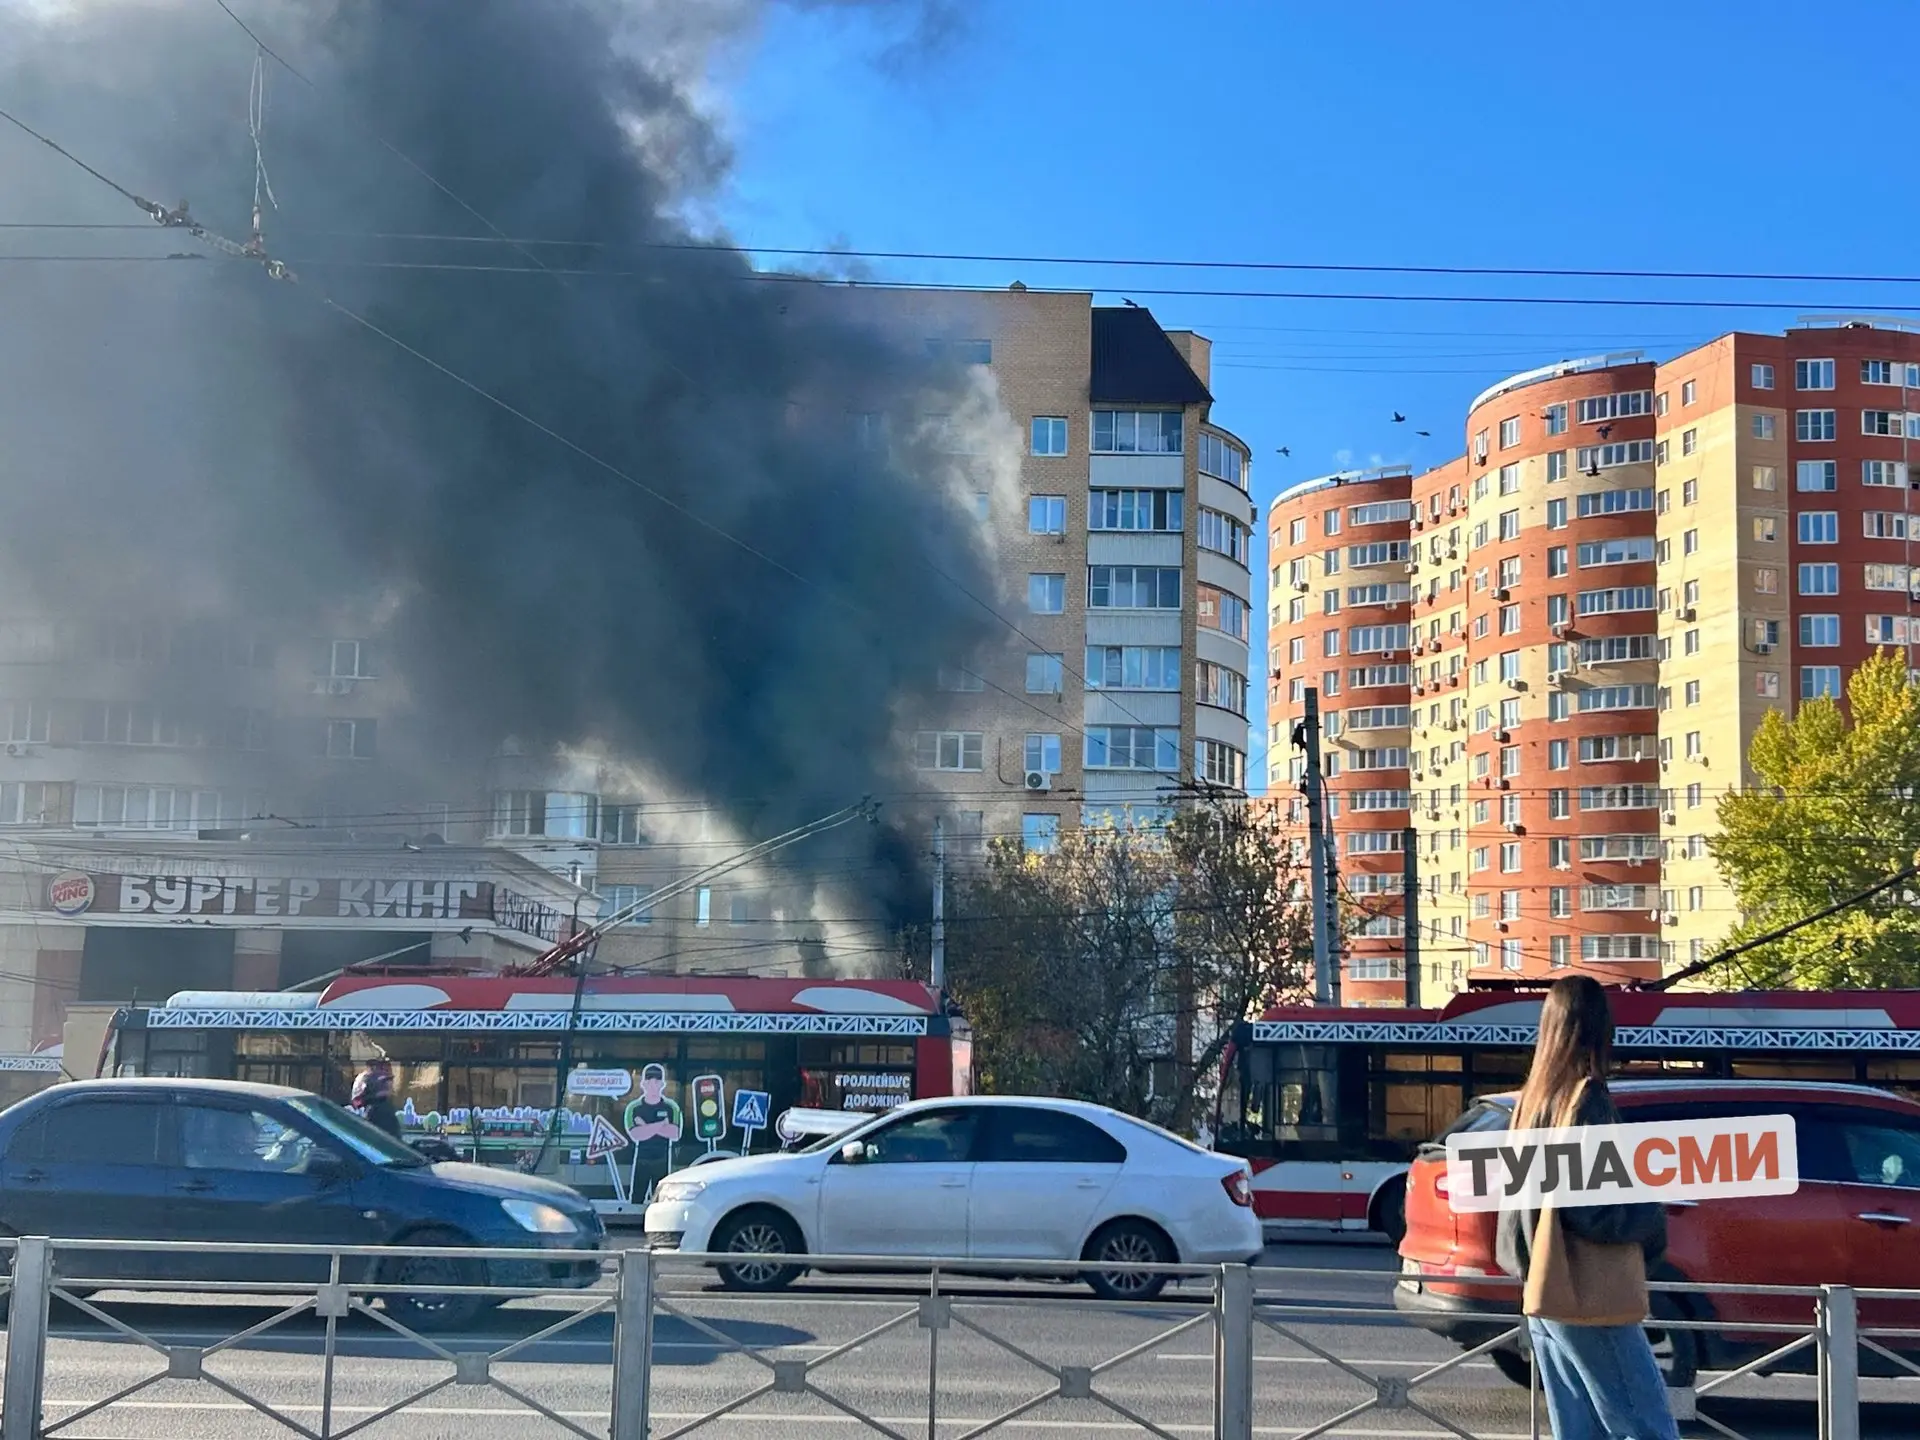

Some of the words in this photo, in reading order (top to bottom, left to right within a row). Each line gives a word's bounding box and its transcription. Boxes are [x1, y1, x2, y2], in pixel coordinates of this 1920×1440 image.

[52, 885, 89, 905] KING
[119, 875, 320, 915] БУРГЕР
[338, 879, 477, 918] КИНГ
